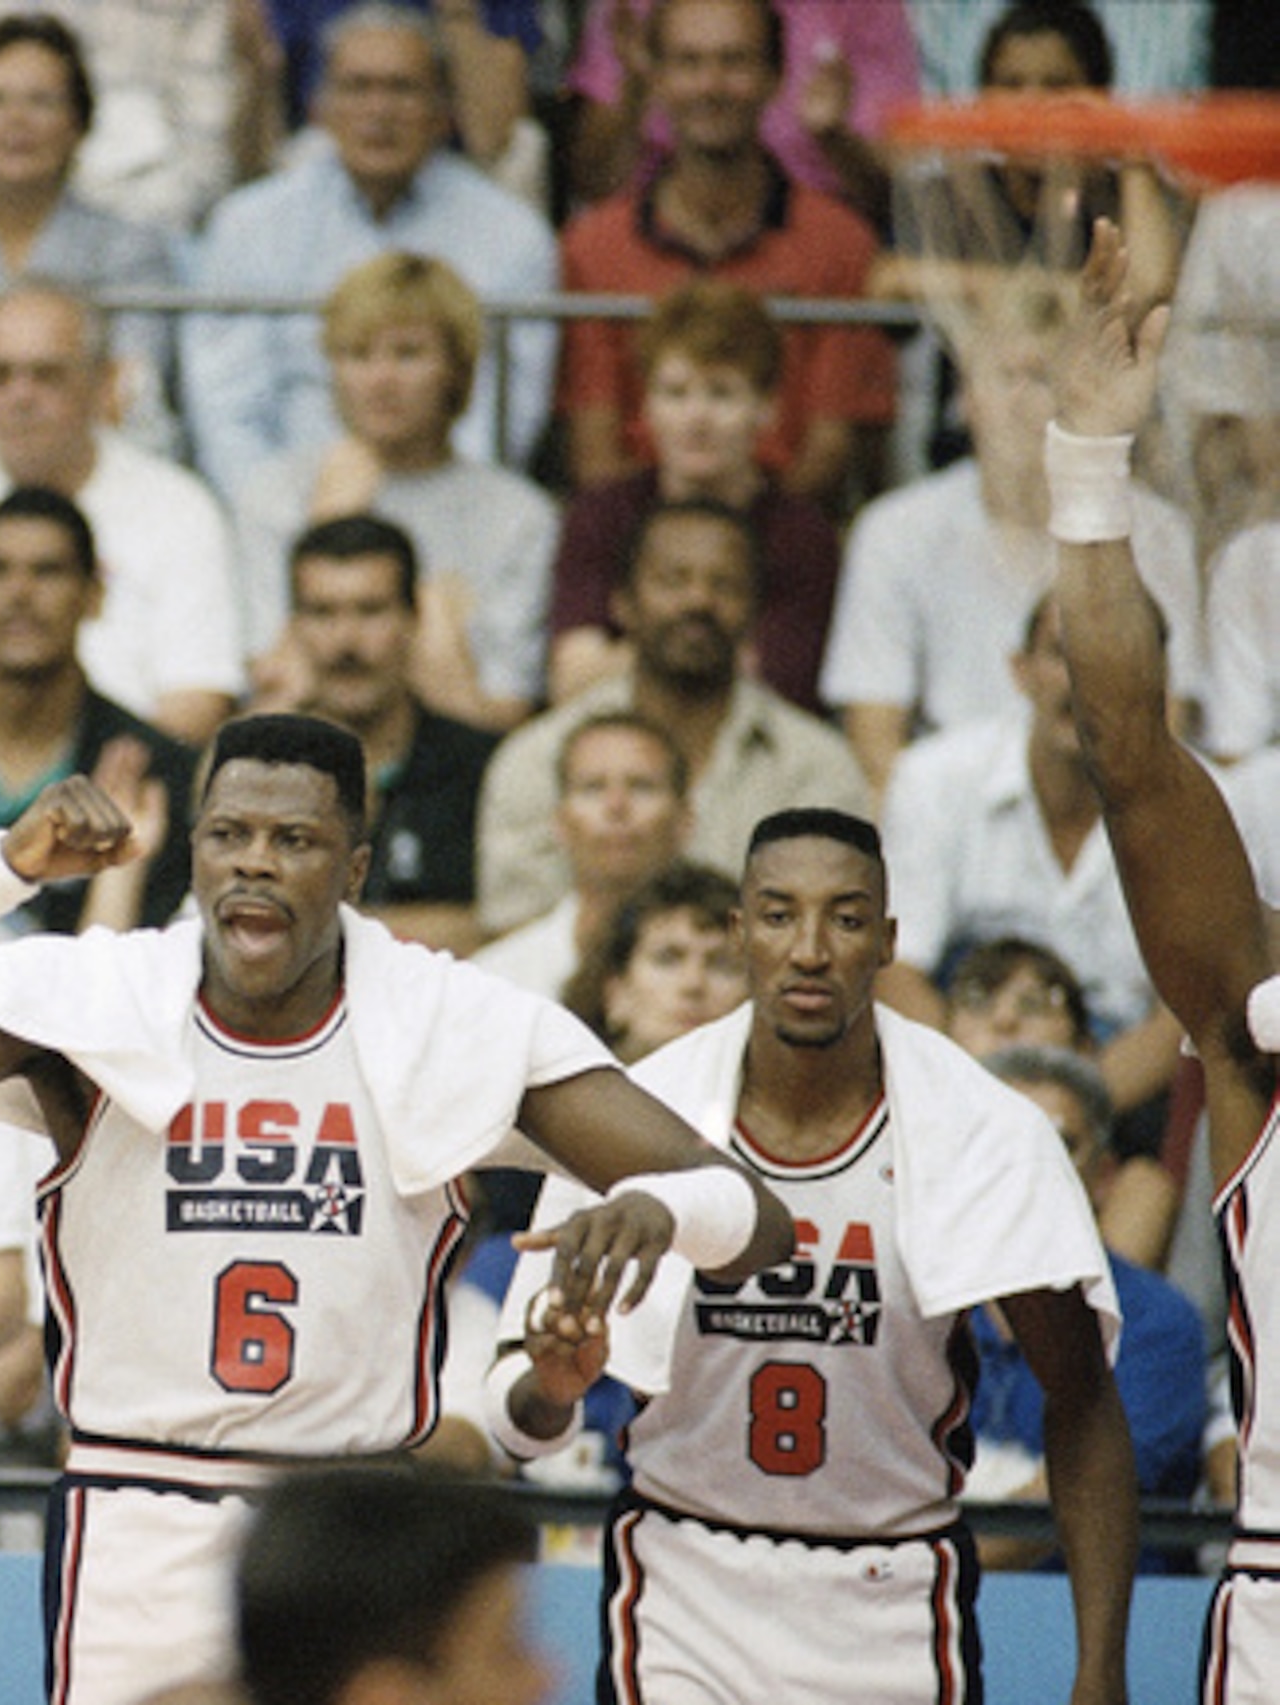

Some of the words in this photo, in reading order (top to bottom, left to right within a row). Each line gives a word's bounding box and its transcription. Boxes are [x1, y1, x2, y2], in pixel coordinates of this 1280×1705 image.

[166, 1099, 363, 1185] USA
[180, 1201, 303, 1223] BASKETBALL
[695, 1217, 881, 1300] SA
[210, 1258, 299, 1396] 6
[748, 1359, 827, 1477] 8
